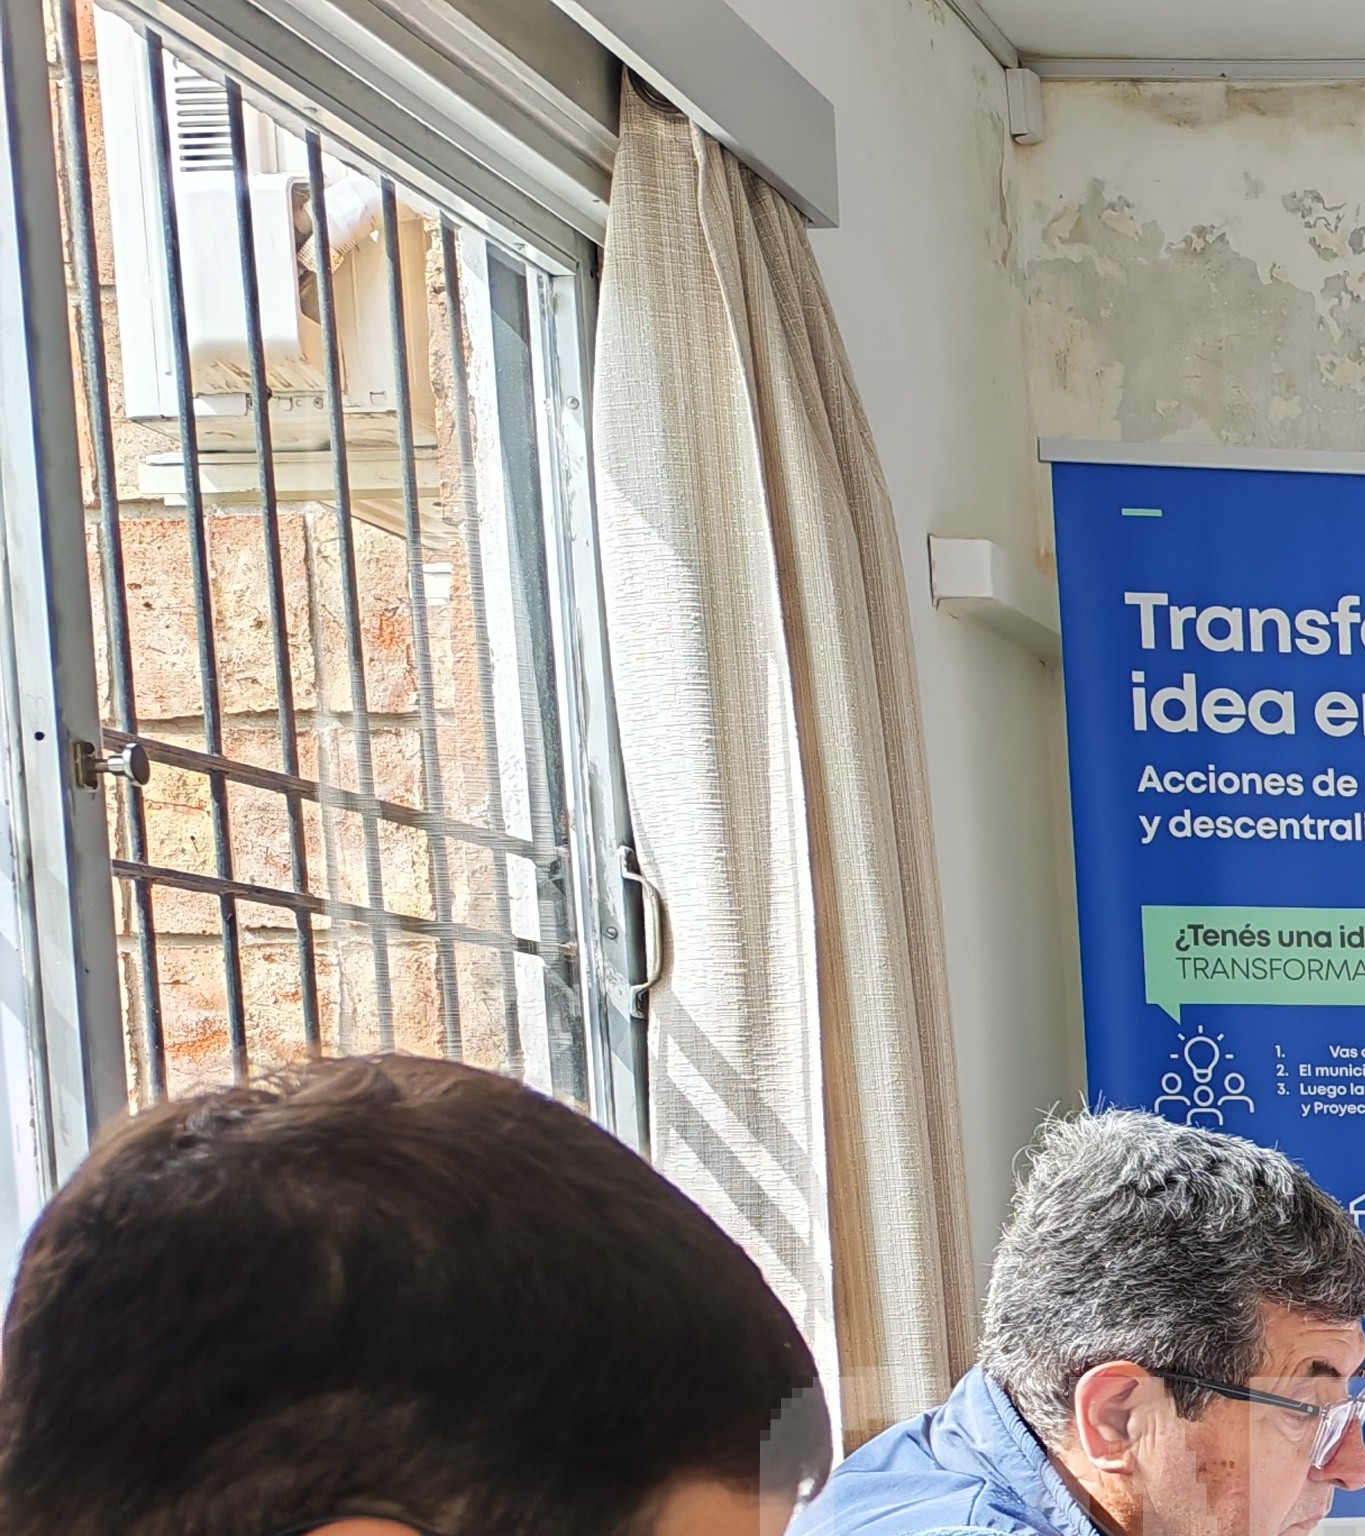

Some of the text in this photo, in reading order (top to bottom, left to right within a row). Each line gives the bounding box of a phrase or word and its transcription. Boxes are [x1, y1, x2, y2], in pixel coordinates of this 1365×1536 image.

[1131, 670, 1296, 735] idea
[1137, 764, 1305, 796] Acciones
[1312, 767, 1358, 797] de
[1138, 815, 1162, 844] y
[1175, 923, 1271, 952] ¿Tenés
[1277, 930, 1333, 949] una
[1275, 1044, 1286, 1058] 1.
[1329, 1045, 1358, 1059] Vas
[1276, 1063, 1289, 1077] 2.
[1298, 1063, 1312, 1077] El
[1277, 1082, 1290, 1096] 3.
[1299, 1082, 1347, 1099] Luego
[1350, 1082, 1365, 1096] la
[1301, 1103, 1311, 1117] y
